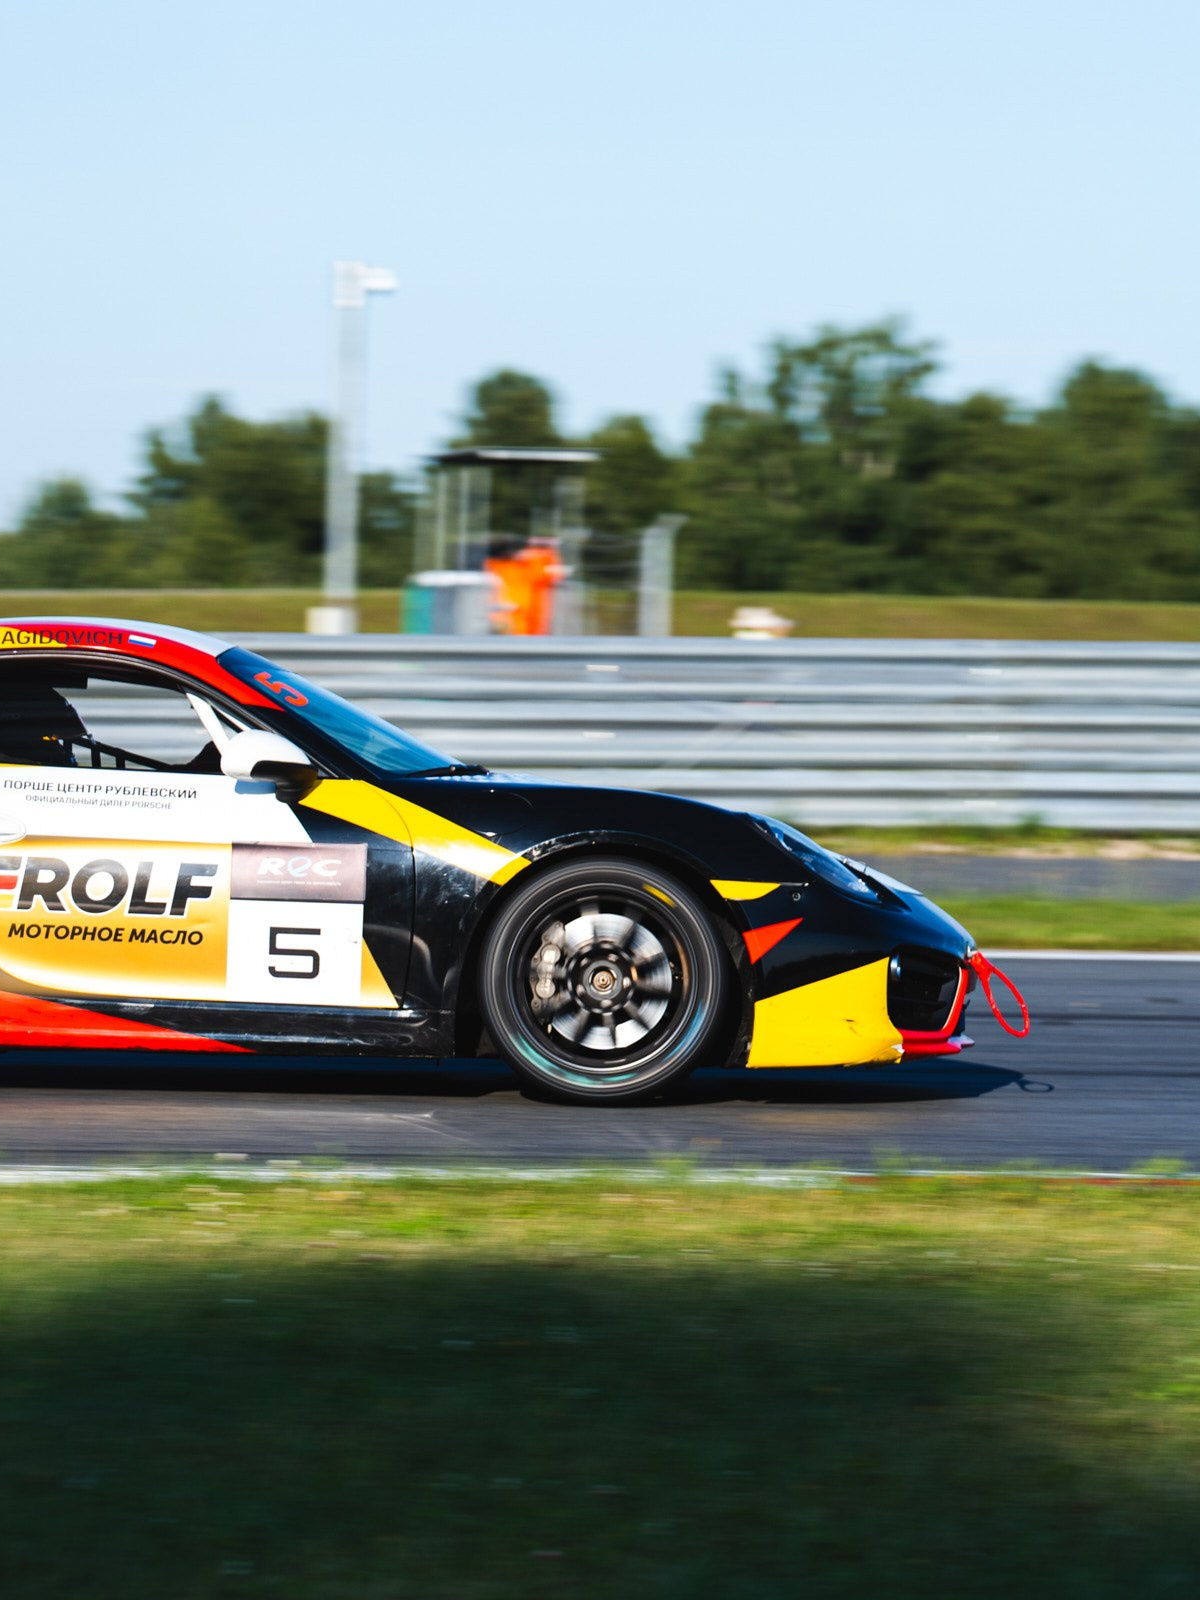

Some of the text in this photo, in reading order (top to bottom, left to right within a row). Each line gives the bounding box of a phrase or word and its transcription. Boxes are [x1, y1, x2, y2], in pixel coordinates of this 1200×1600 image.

[253, 671, 308, 707] 5
[3, 779, 197, 799] ПОРШЕ ЦЕНТР РУБЛЕВСКИЙ
[99, 798, 131, 808] ДИЛЕР
[131, 800, 173, 811] PORSCHE
[8, 923, 204, 946] МОТОРНОЕ МАСЛО
[268, 927, 321, 980] 5
